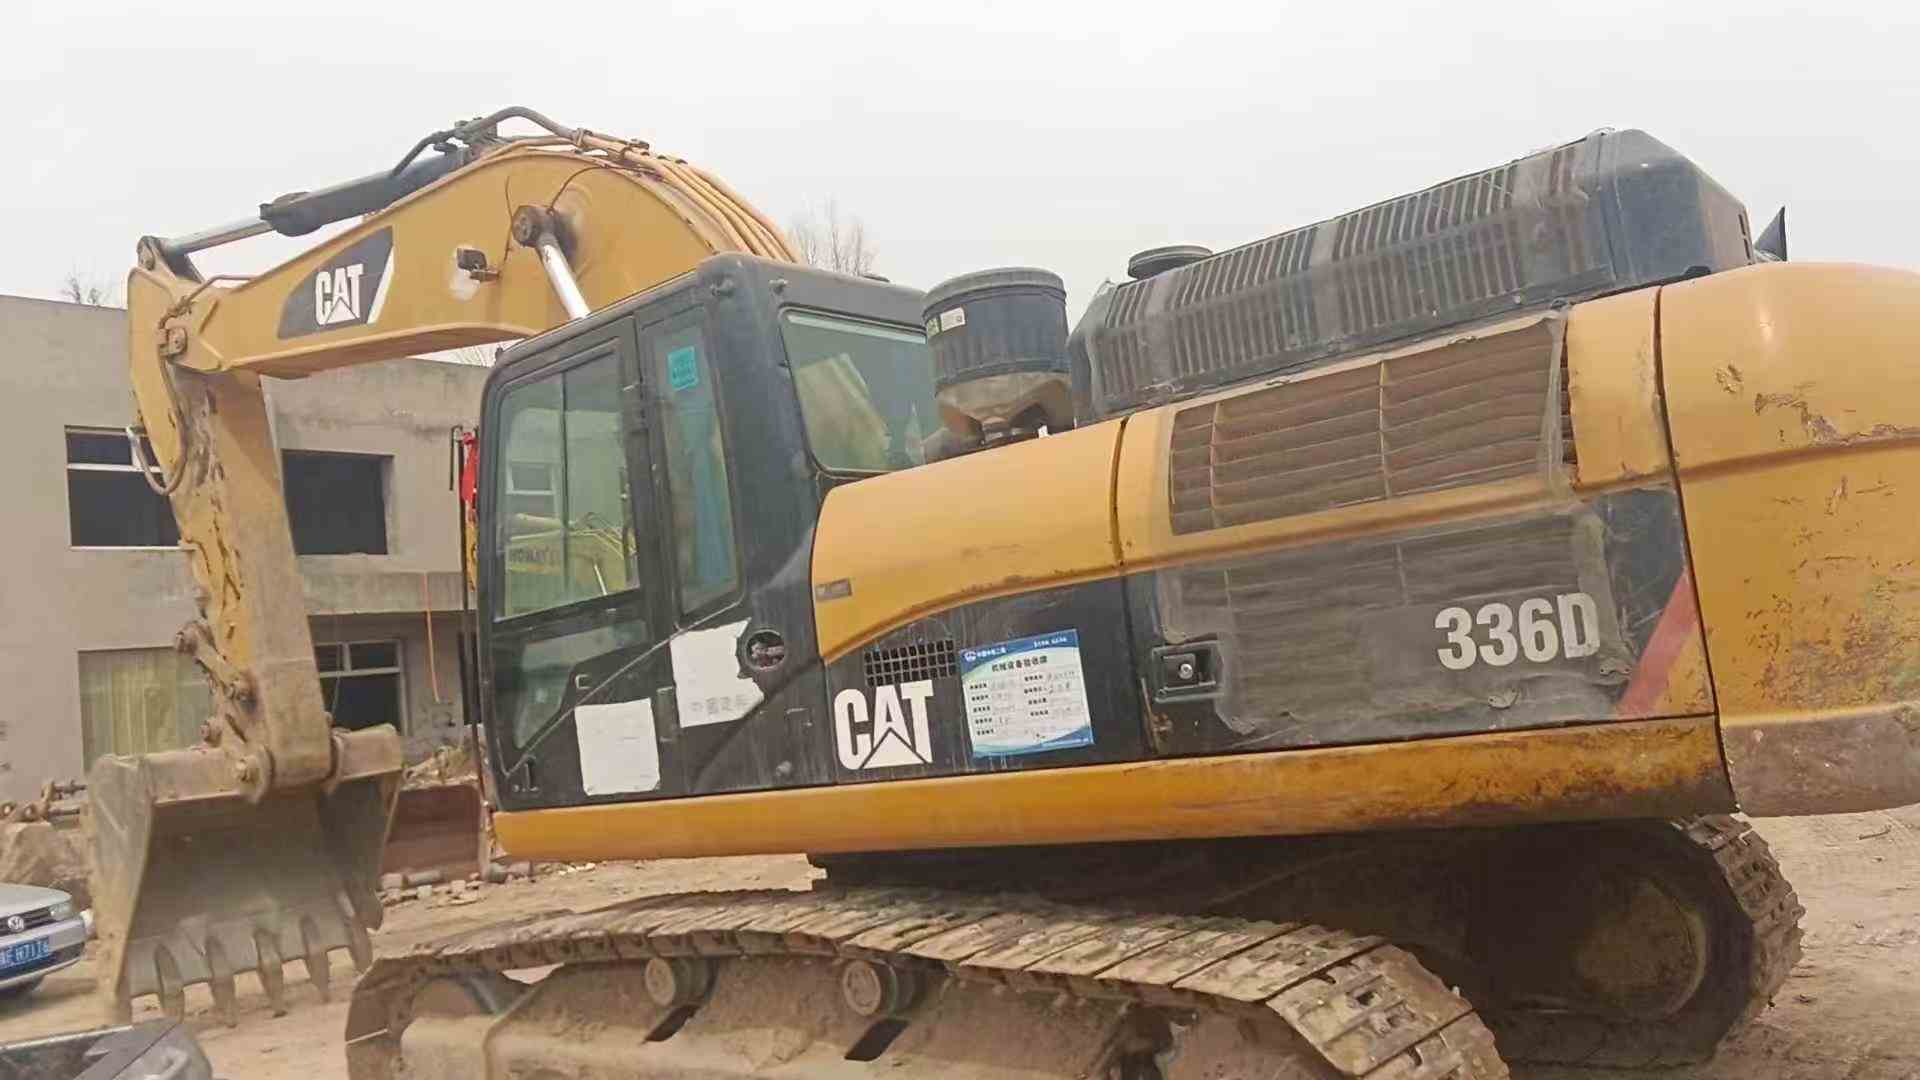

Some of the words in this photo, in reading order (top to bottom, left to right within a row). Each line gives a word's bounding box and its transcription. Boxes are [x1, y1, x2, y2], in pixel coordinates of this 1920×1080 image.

[315, 263, 364, 325] CAT
[1434, 592, 1600, 670] 336D
[834, 679, 934, 770] CAT
